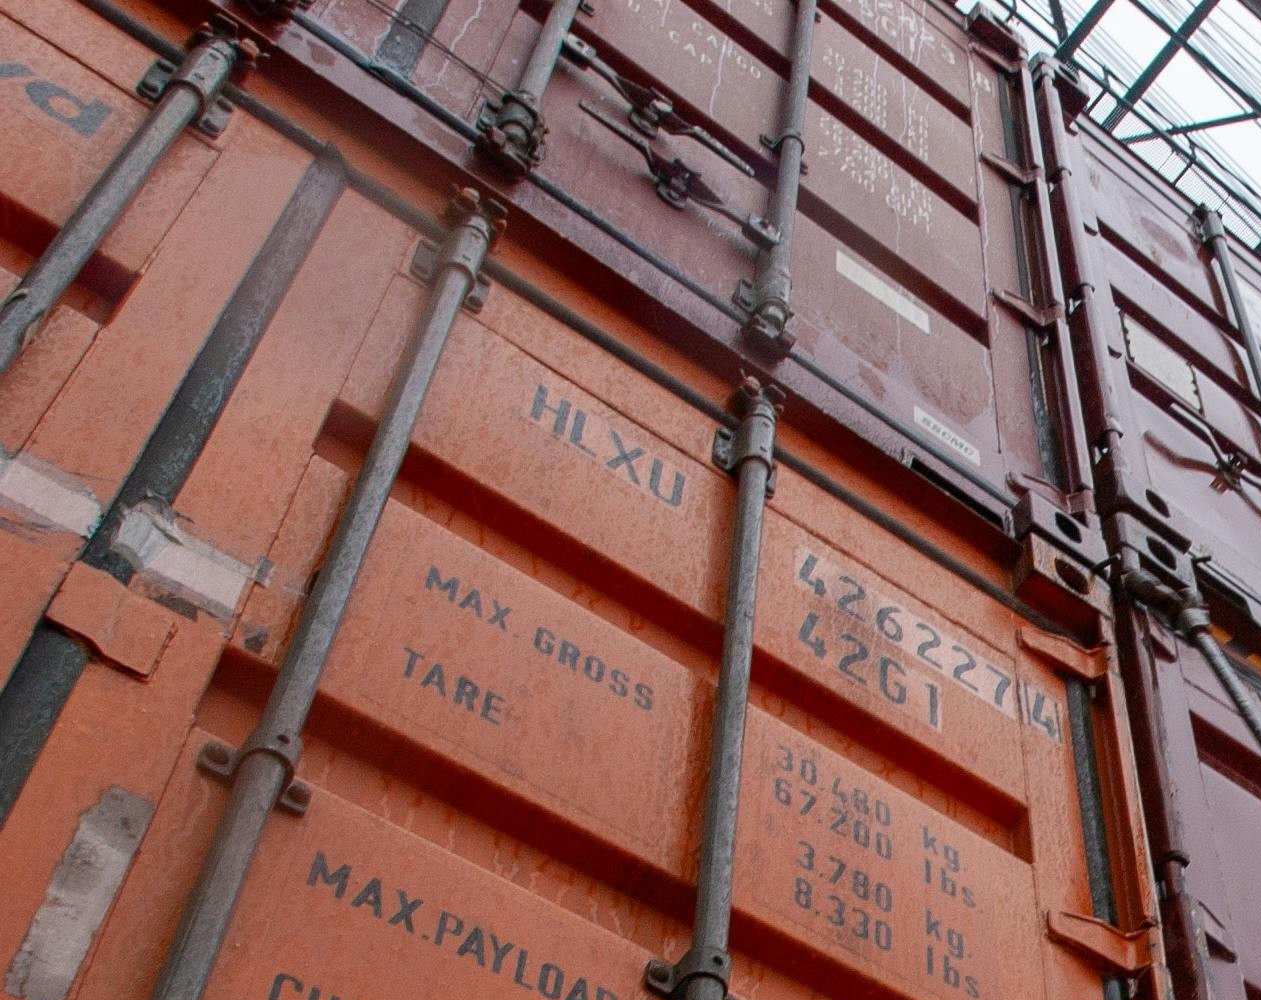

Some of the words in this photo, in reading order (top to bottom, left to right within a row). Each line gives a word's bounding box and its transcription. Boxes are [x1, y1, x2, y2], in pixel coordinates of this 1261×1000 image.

[530, 384, 687, 509] HLXU
[399, 646, 505, 727] TARE
[424, 564, 520, 638] MAX.
[532, 626, 655, 712] GROSS
[797, 611, 939, 729] 42G1
[799, 553, 1012, 709] 426227
[1031, 690, 1058, 738] 4
[774, 778, 893, 860] 67.200
[794, 877, 893, 951] 8.330
[795, 841, 893, 913] 3.780
